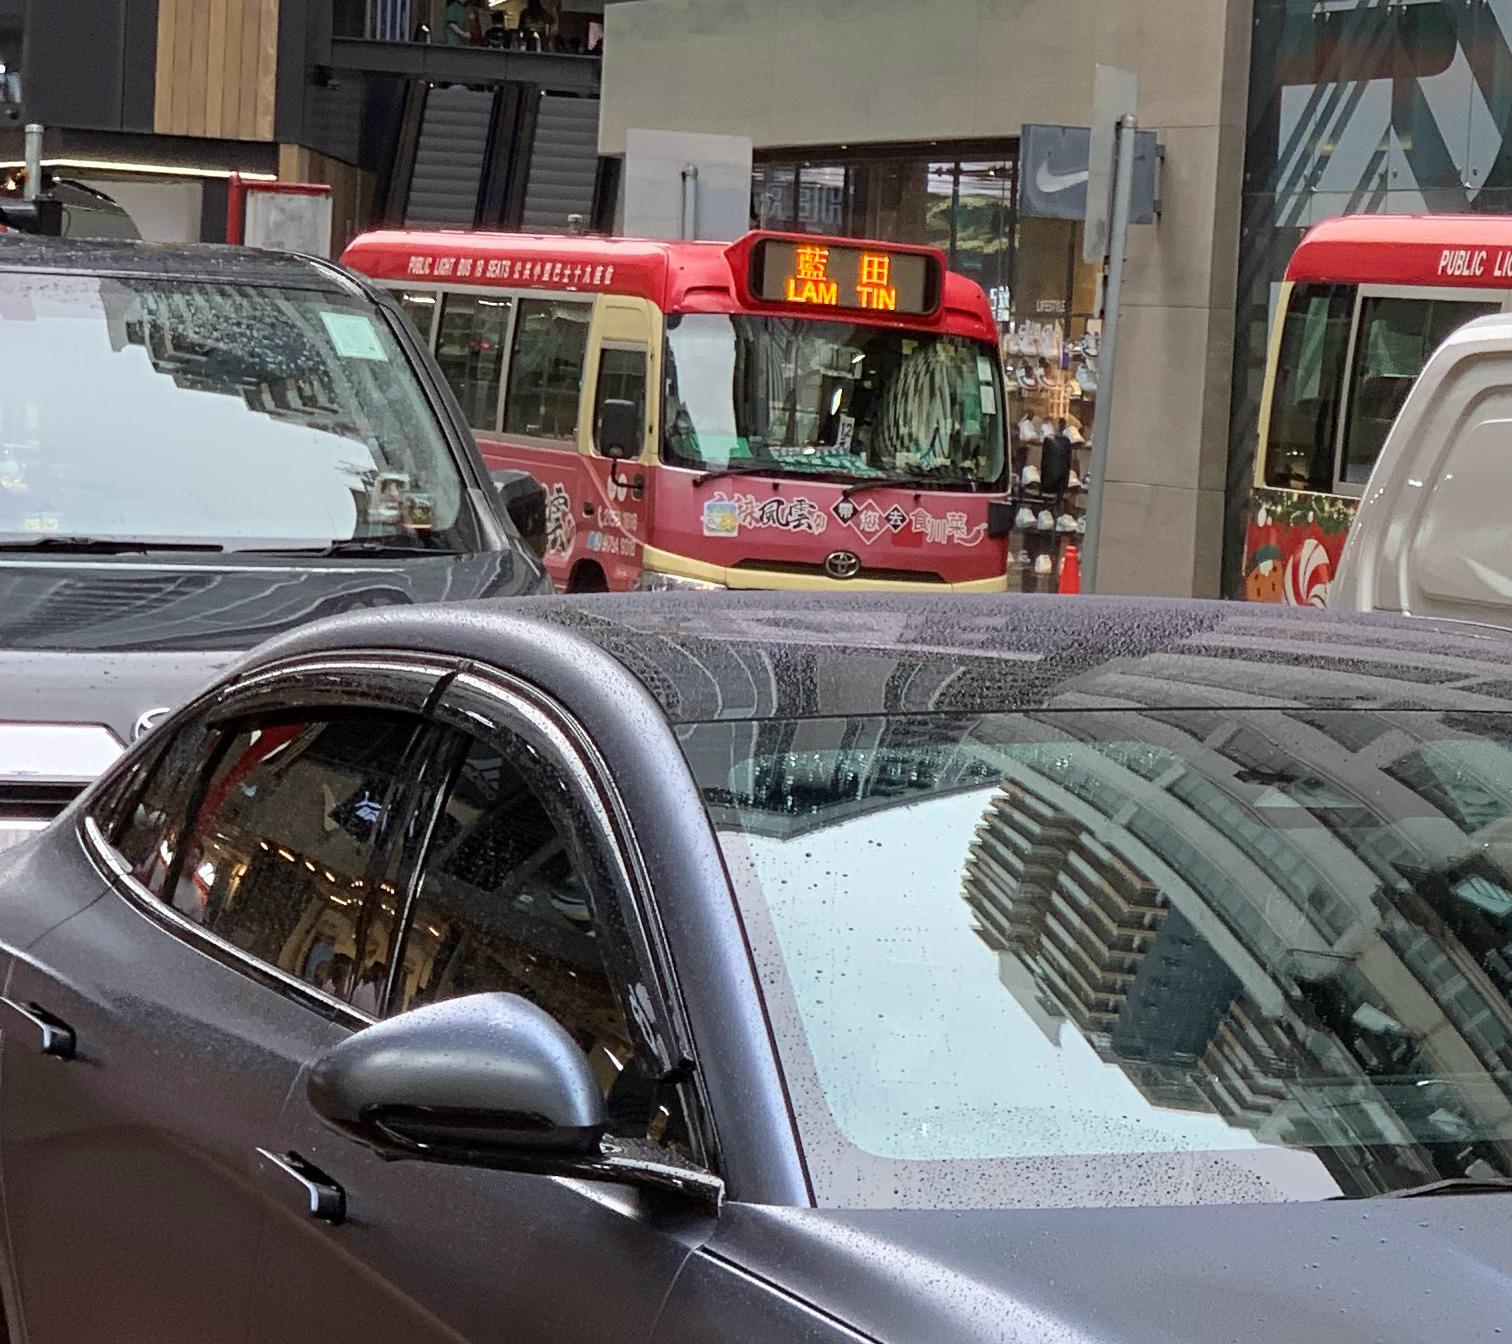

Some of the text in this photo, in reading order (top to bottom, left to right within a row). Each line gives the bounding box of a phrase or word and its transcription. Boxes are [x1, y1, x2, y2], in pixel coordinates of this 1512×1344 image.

[795, 247, 891, 287] 藍田
[1438, 249, 1487, 276] PUBLIC
[786, 278, 896, 312] LAM TIN
